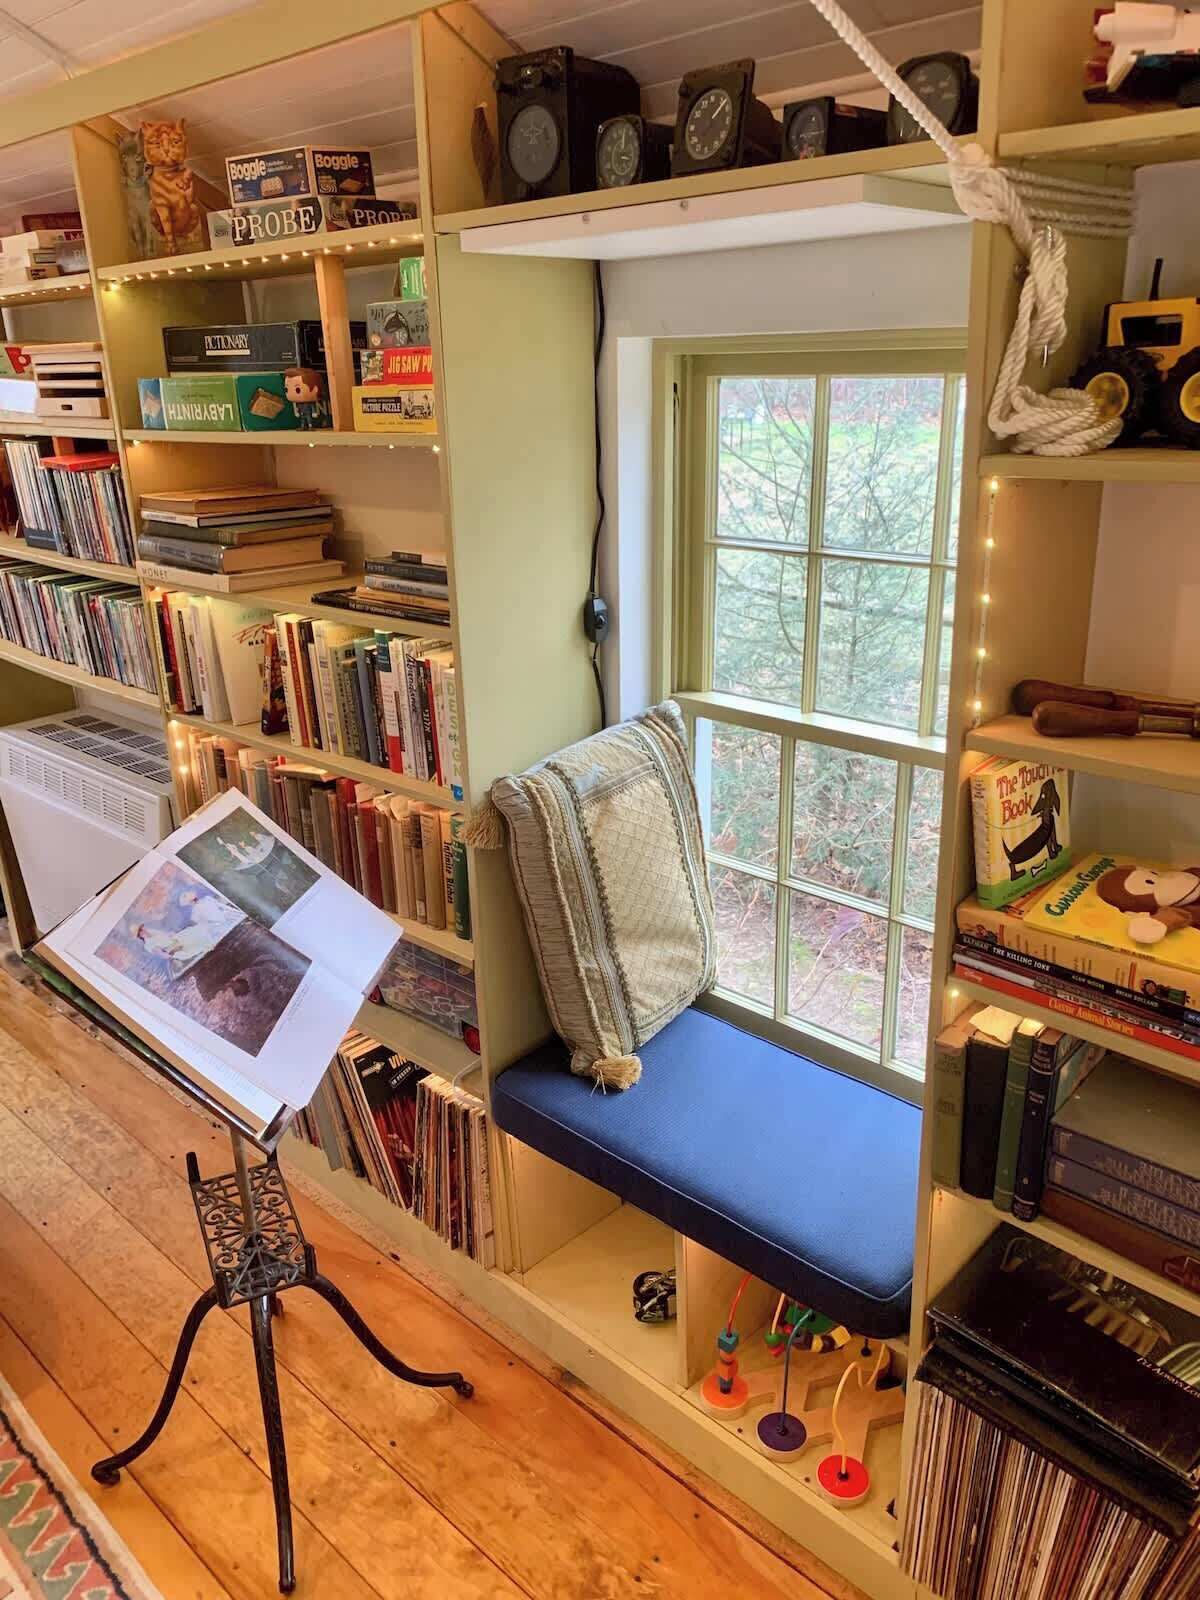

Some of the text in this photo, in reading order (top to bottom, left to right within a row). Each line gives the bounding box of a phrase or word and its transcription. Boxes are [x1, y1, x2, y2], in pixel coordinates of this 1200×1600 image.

[230, 159, 267, 181] Boggle
[313, 153, 359, 170] Boggle
[232, 206, 316, 241] PROBE
[204, 333, 250, 350] PICTIONARY
[167, 402, 233, 421] LABYRINTH
[142, 567, 168, 580] MONET
[996, 775, 1018, 799] The
[1001, 791, 1034, 825] Book
[443, 841, 455, 904] Infinite Riches
[1044, 880, 1090, 917] Curious
[993, 947, 1005, 958] THE
[1006, 951, 1033, 966] KILLING
[1034, 960, 1051, 972] JOKE
[1049, 999, 1075, 1016] Classic
[1076, 1005, 1106, 1026] Animal
[1106, 1014, 1134, 1036] Stories
